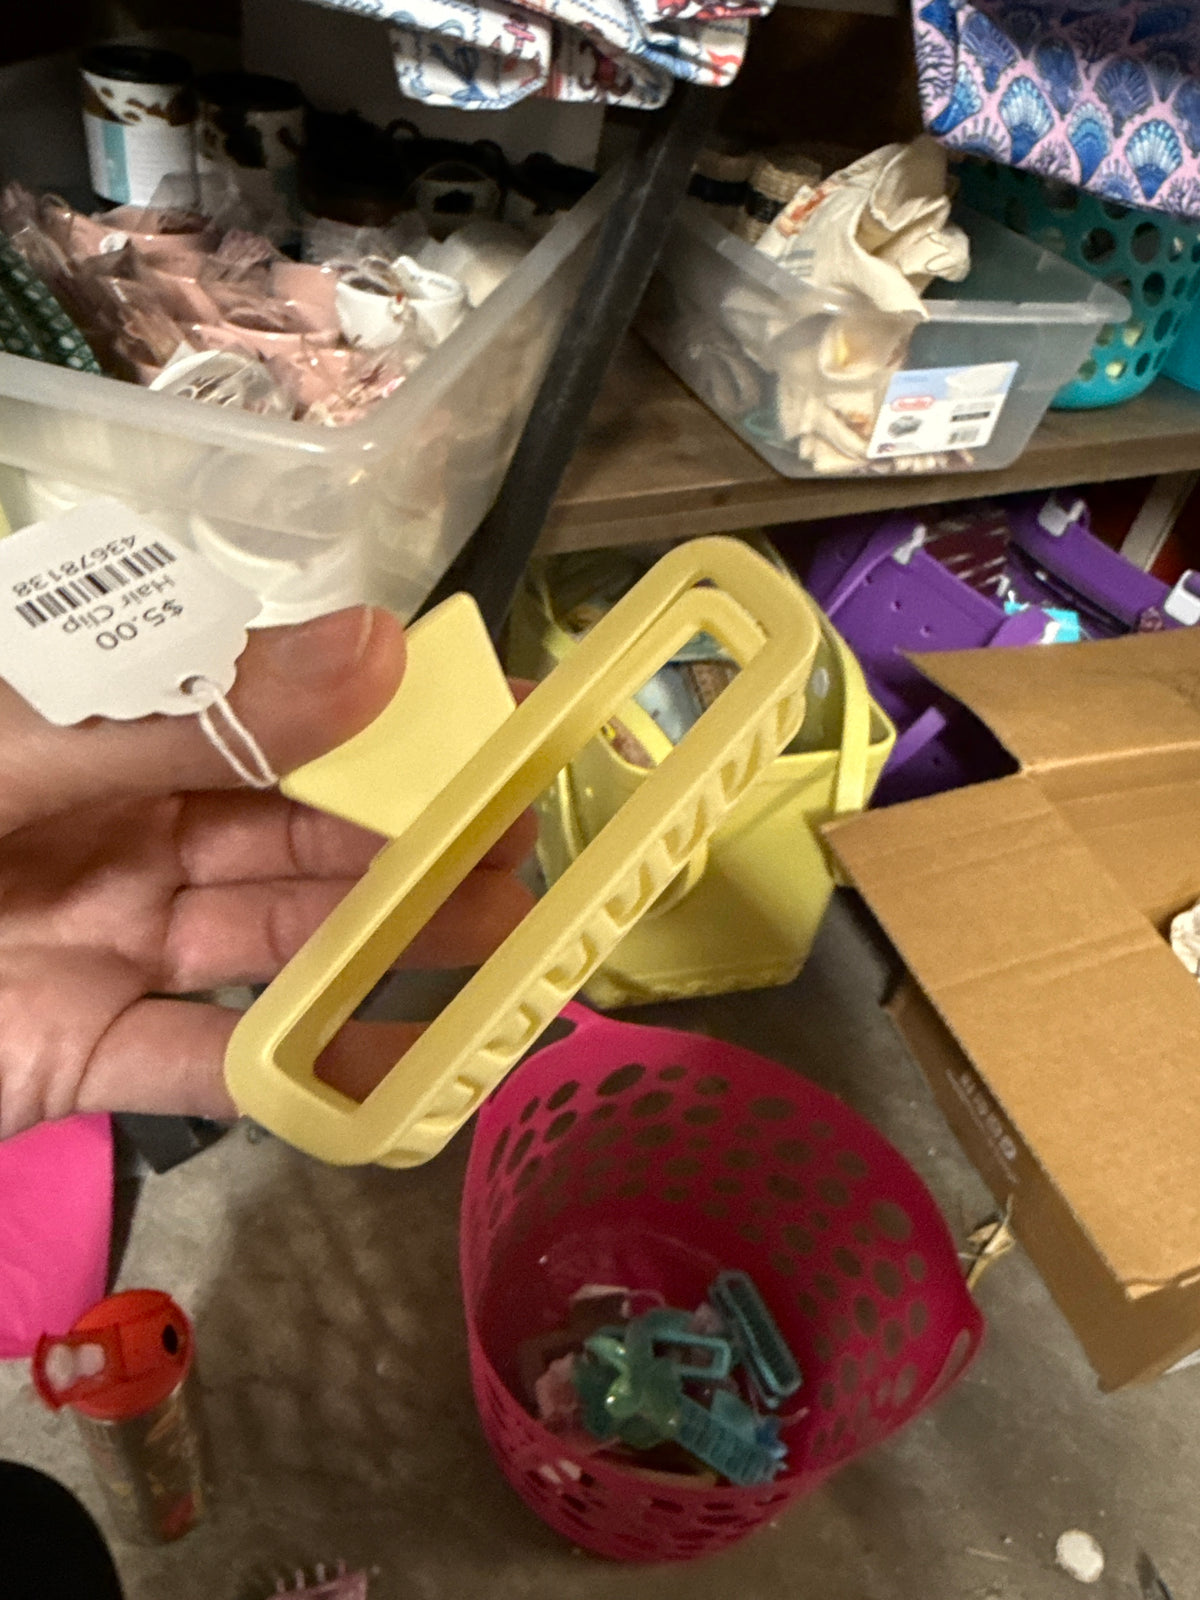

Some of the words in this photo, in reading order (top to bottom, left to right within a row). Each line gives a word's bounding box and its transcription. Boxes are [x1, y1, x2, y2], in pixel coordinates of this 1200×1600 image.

[12, 534, 137, 598] 43678138
[120, 574, 176, 608] Hair
[62, 604, 115, 634] Clip
[95, 598, 184, 650] $5.00
